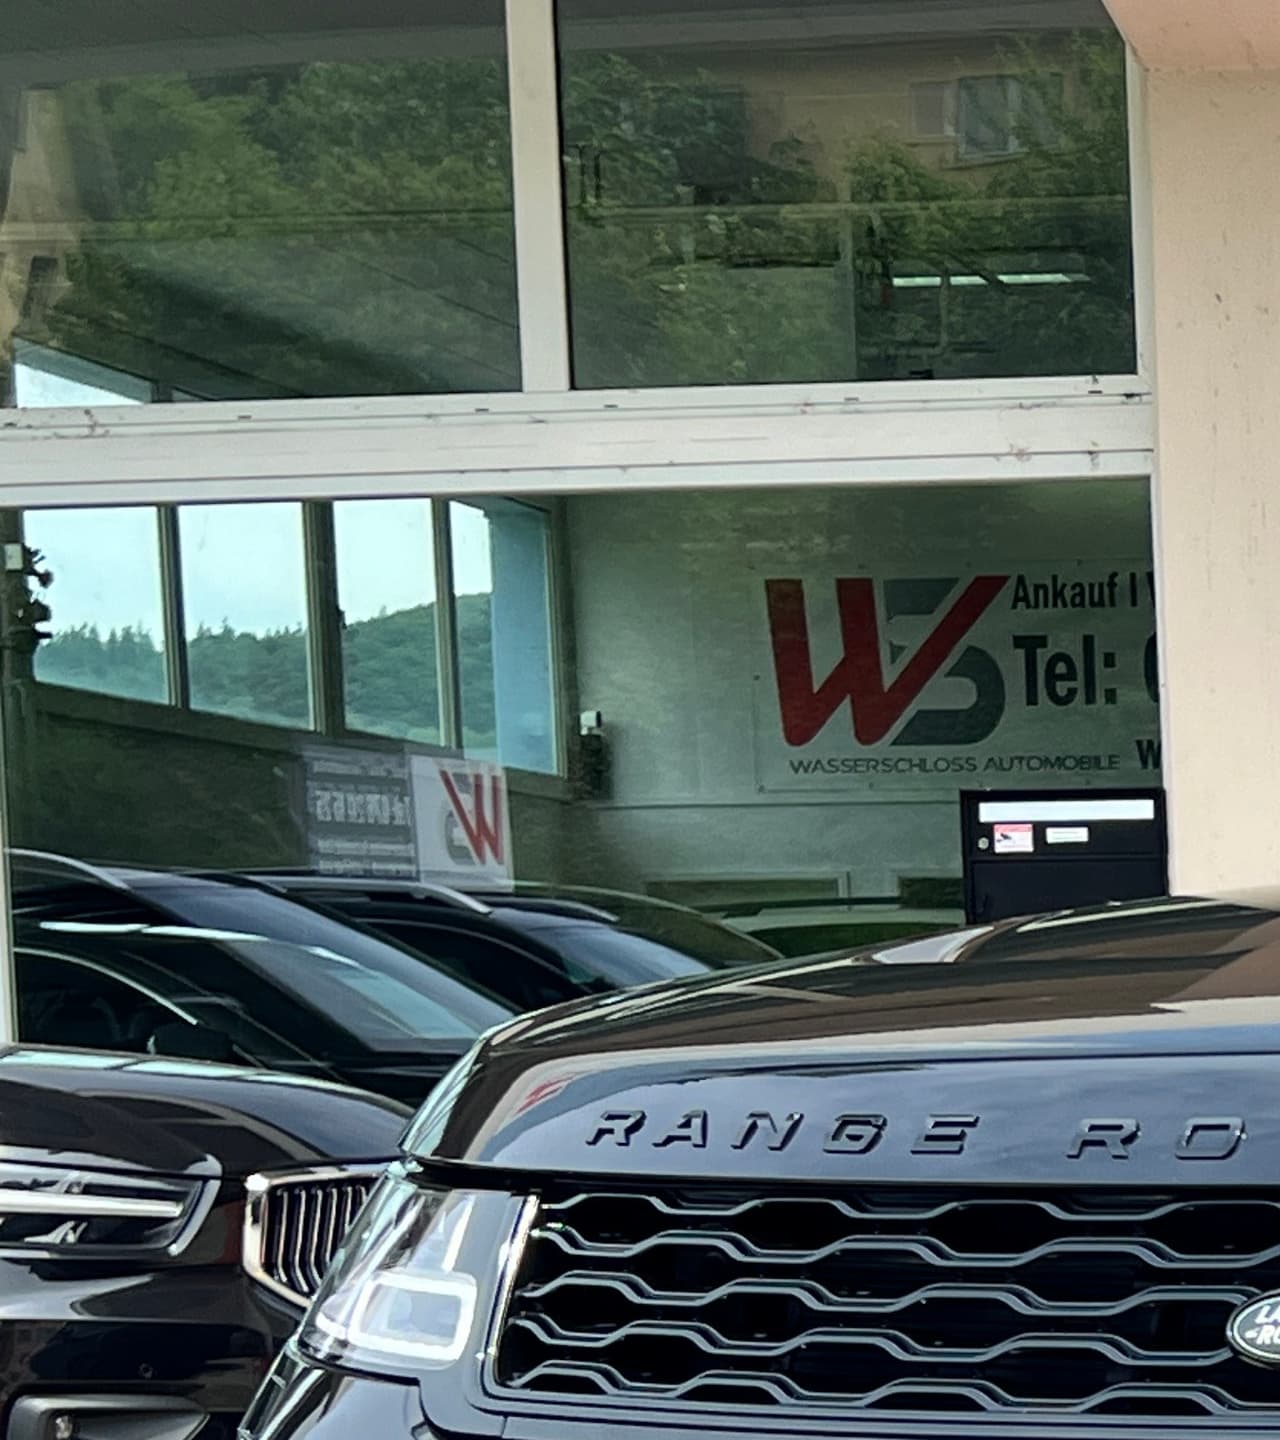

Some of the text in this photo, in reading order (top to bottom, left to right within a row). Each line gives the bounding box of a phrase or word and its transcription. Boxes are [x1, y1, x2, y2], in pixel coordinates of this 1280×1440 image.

[1011, 572, 1119, 610] Ankauf
[1012, 634, 1118, 706] Tel:
[789, 754, 1121, 774] WASSERSCHLOSS AUTOMOBILE
[585, 1110, 981, 1155] RANGE
